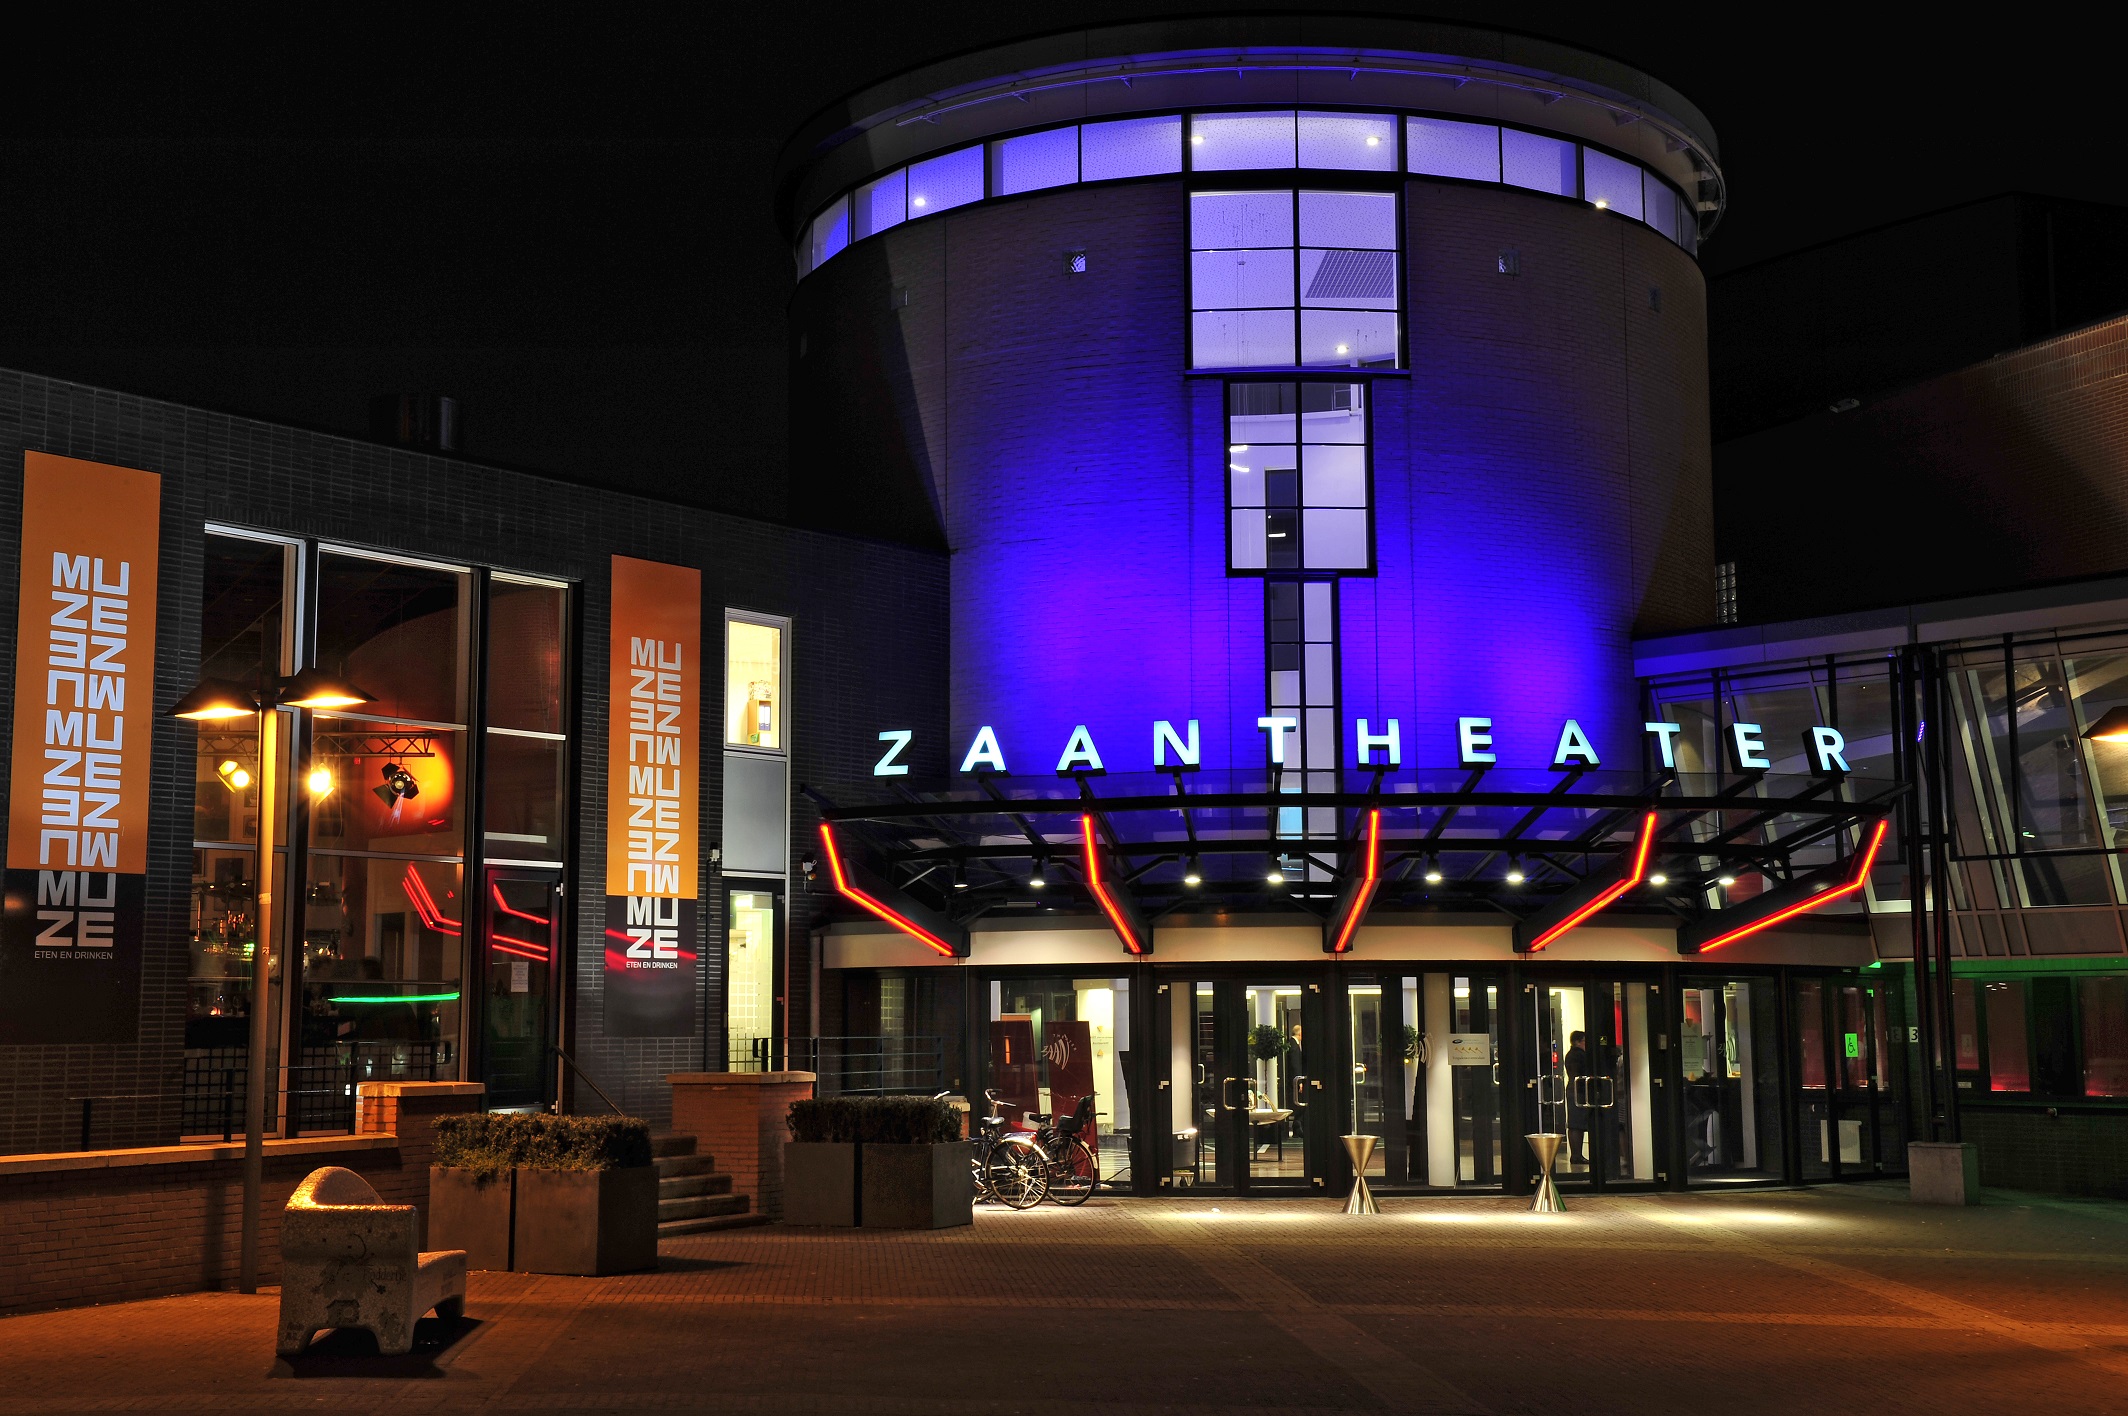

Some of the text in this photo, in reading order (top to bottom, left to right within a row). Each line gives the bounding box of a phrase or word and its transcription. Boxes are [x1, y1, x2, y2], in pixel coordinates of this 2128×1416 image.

[34, 951, 113, 960] ETEN EN DRINKEN
[626, 961, 678, 969] ETEN EN DRINKEN
[1041, 1038, 1070, 1071] ZAAN
